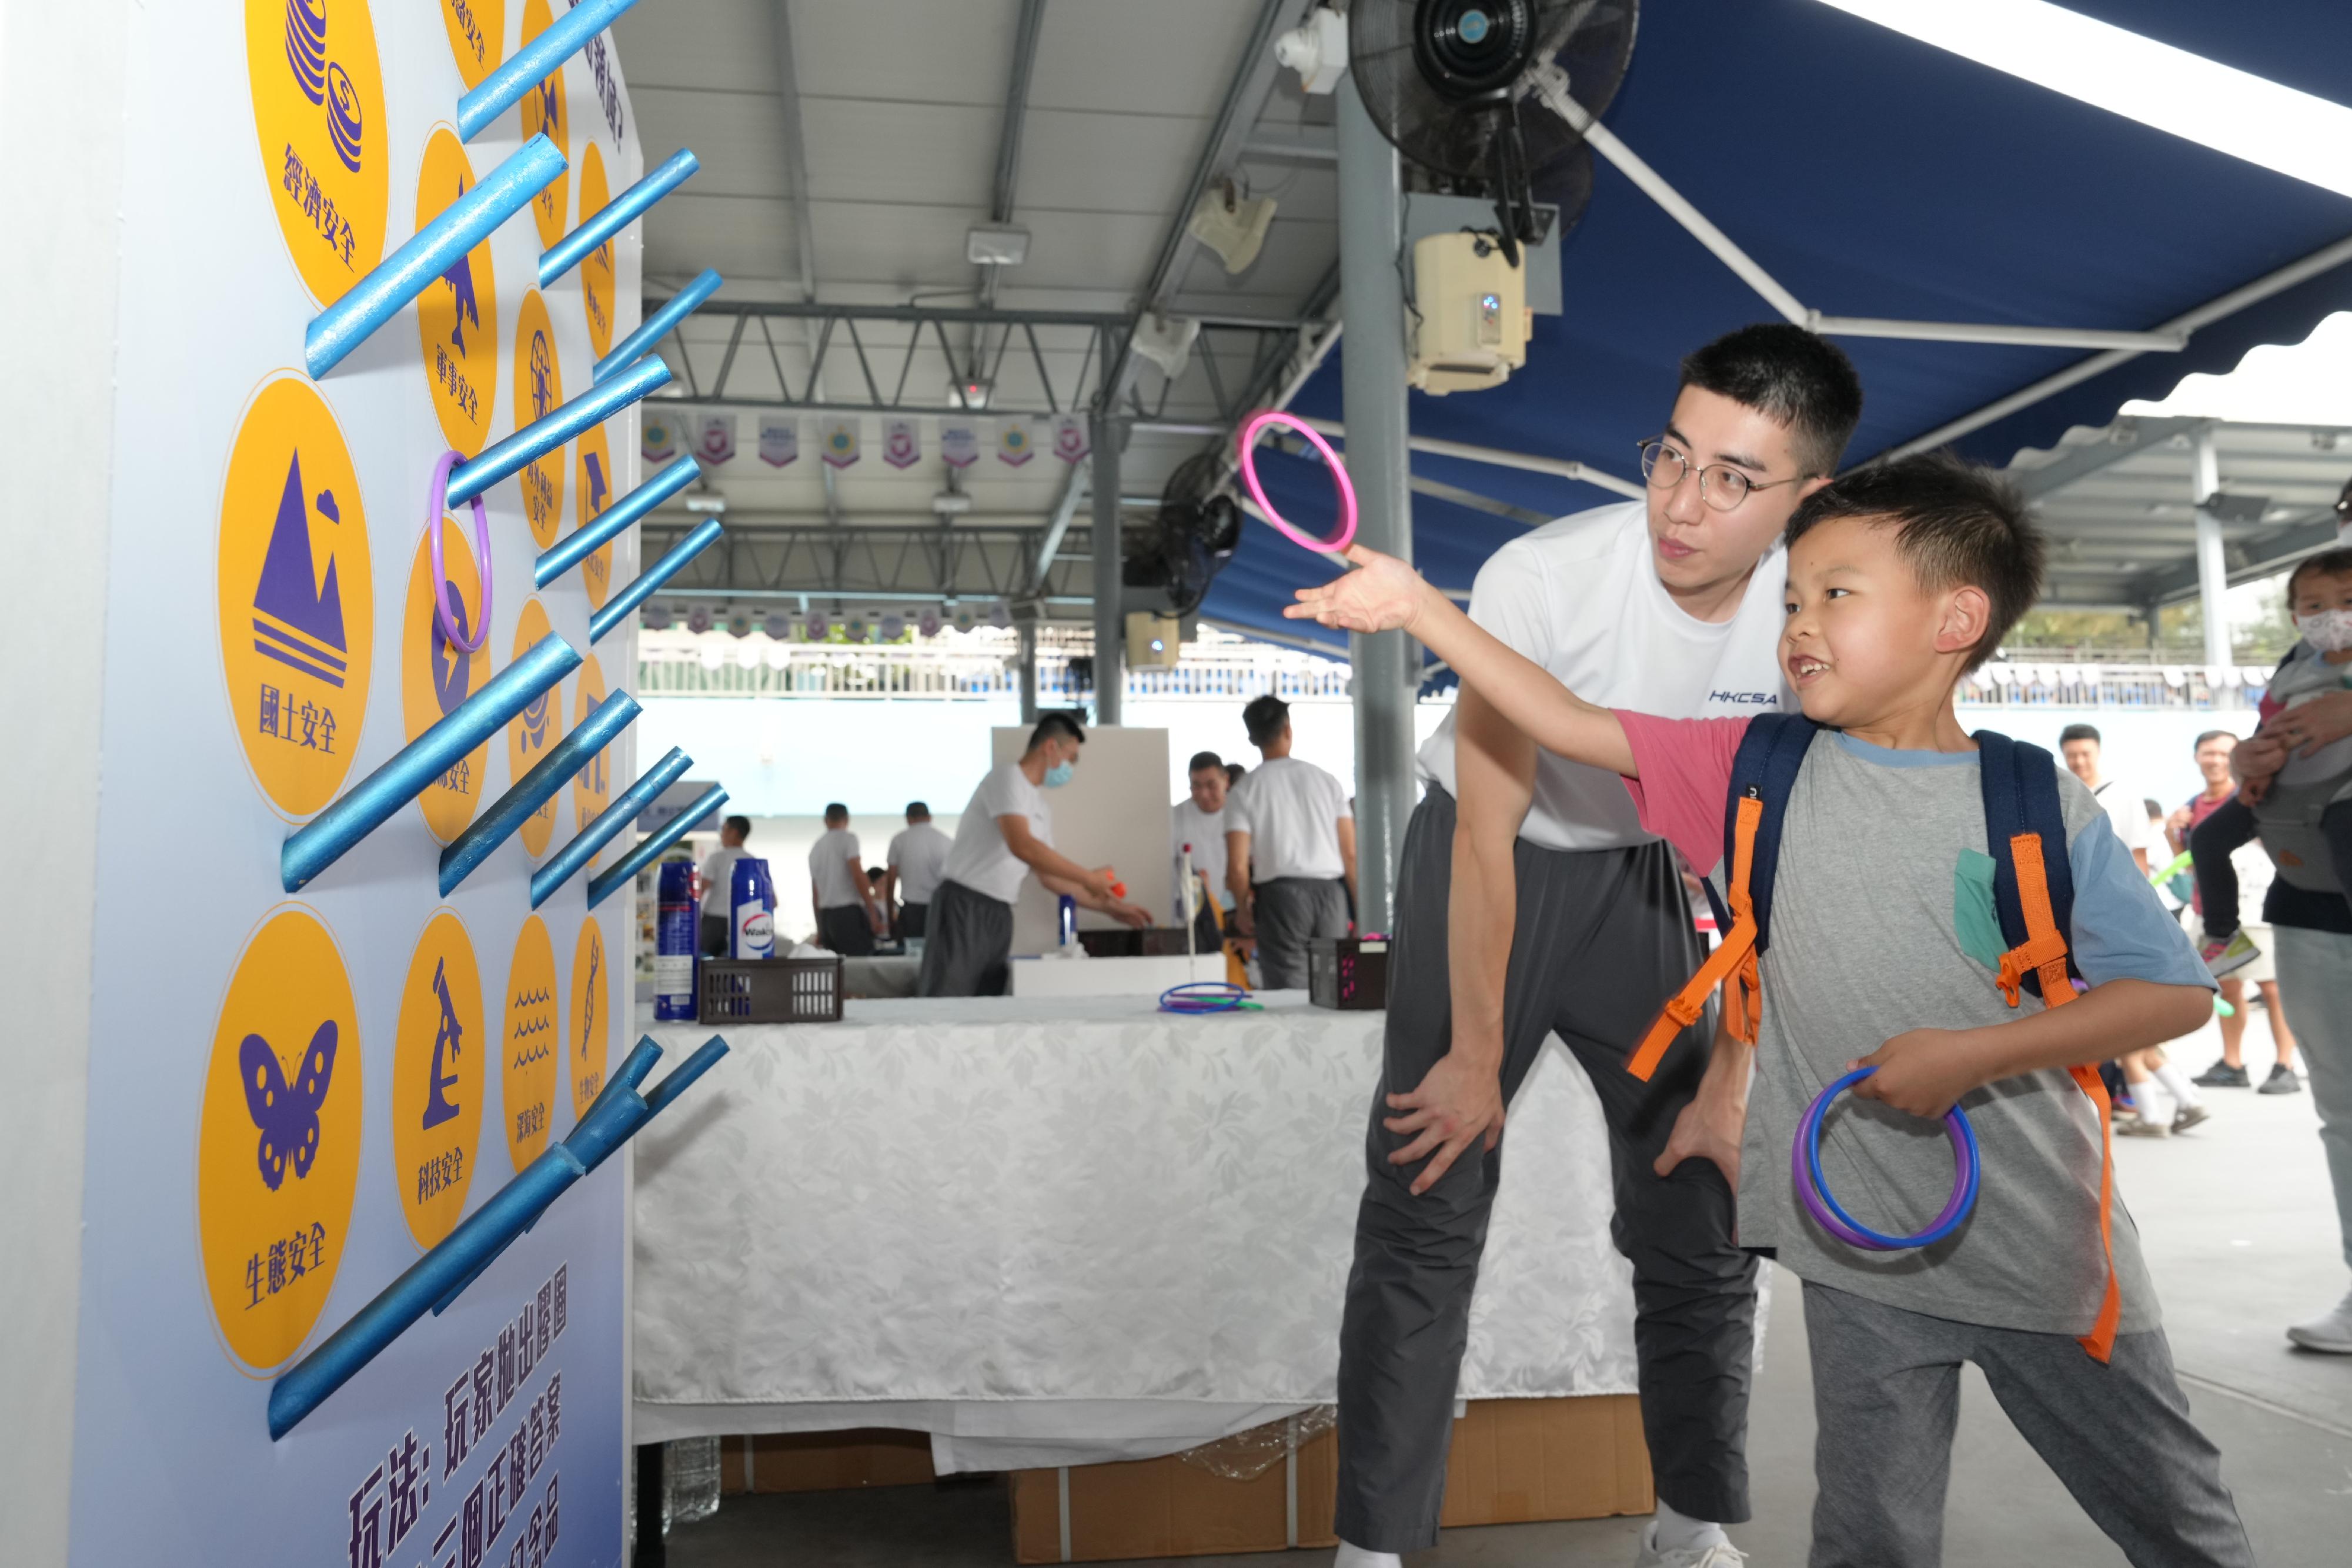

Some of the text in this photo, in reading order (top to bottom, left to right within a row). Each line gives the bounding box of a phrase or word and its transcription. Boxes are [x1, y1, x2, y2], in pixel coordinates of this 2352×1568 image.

[283, 142, 356, 273] 經濟安全
[436, 343, 477, 426] 軍事安全
[533, 494, 546, 532] 安全
[260, 683, 336, 754] 國土安全
[1709, 690, 1778, 706] HKCSA
[517, 1101, 544, 1144] 深海安全
[417, 1146, 463, 1205] 科技安全
[245, 1221, 326, 1310] 生態安全
